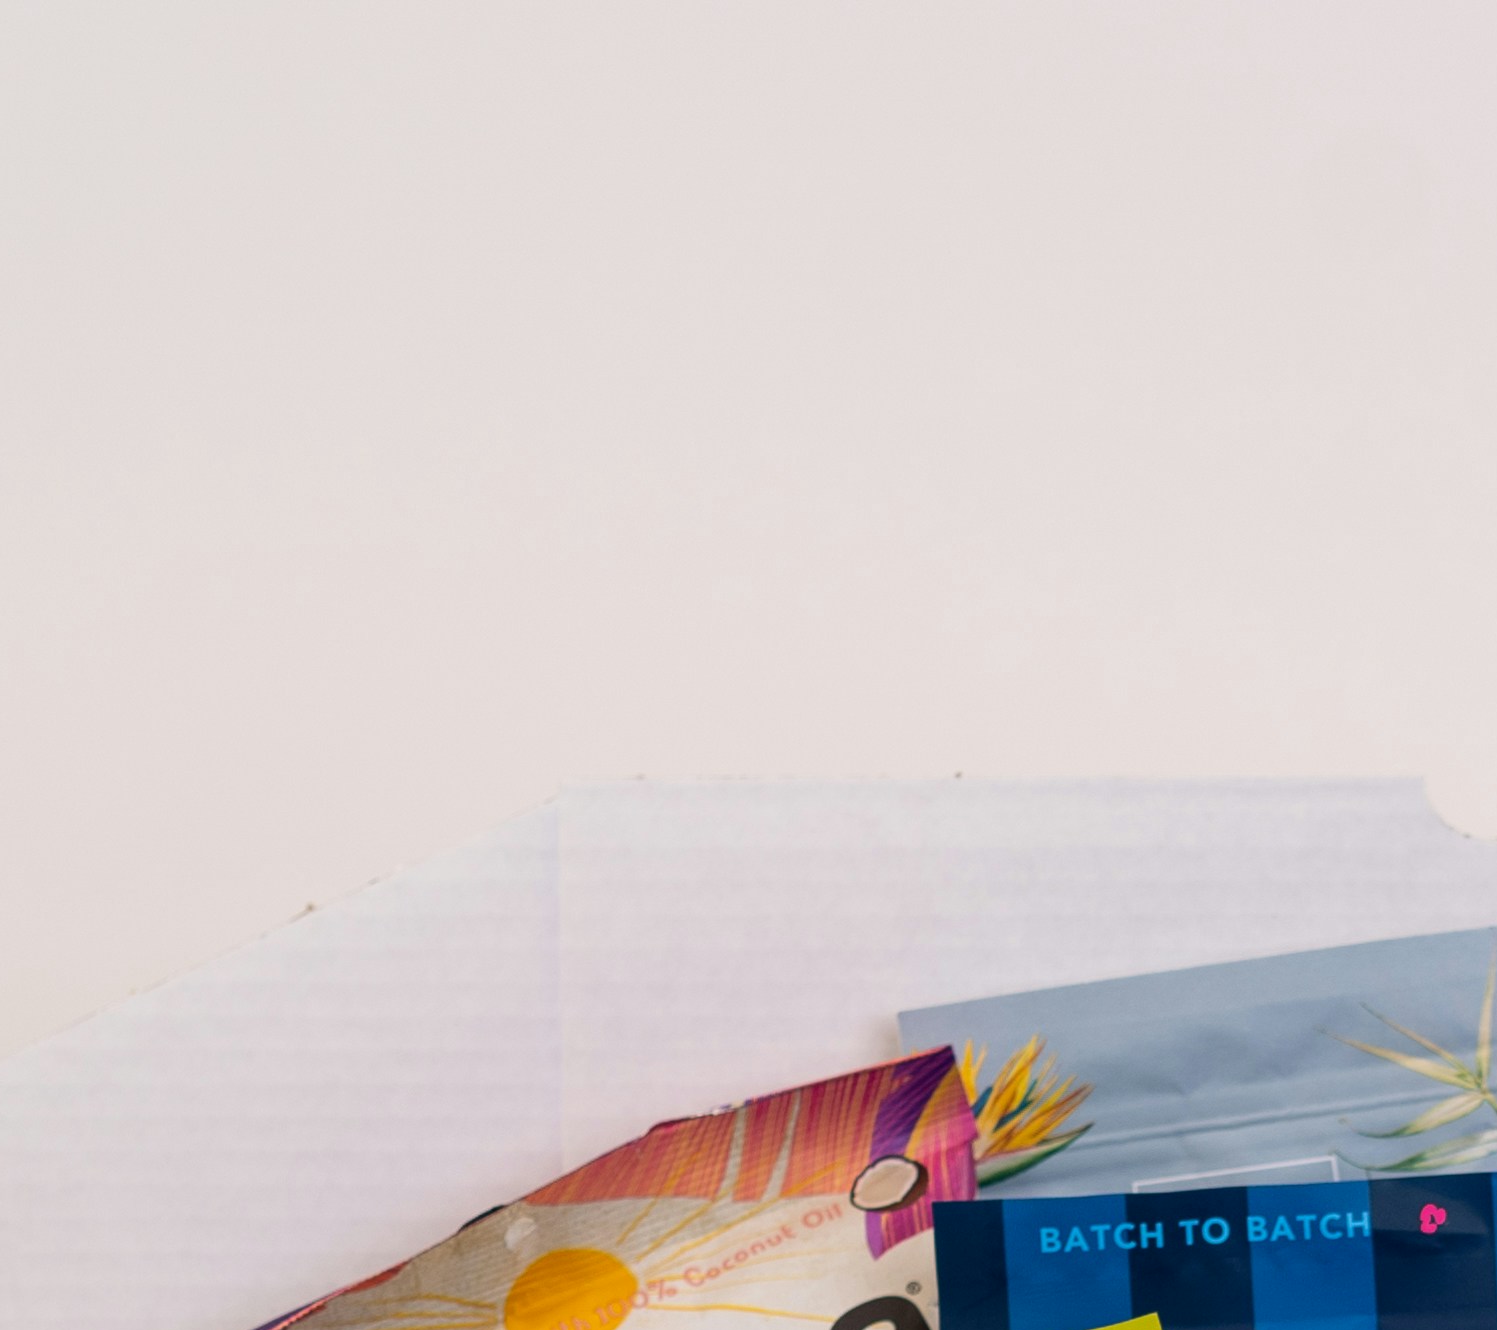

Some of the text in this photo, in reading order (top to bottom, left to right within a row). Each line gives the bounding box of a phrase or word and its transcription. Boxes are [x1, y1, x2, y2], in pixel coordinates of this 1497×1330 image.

[596, 1278, 678, 1326] 100%
[682, 1225, 798, 1289] Coconut
[803, 1203, 843, 1230] Oil
[1039, 1221, 1165, 1254] BATCH
[1178, 1217, 1230, 1247] TO
[1246, 1211, 1371, 1243] BATCH
